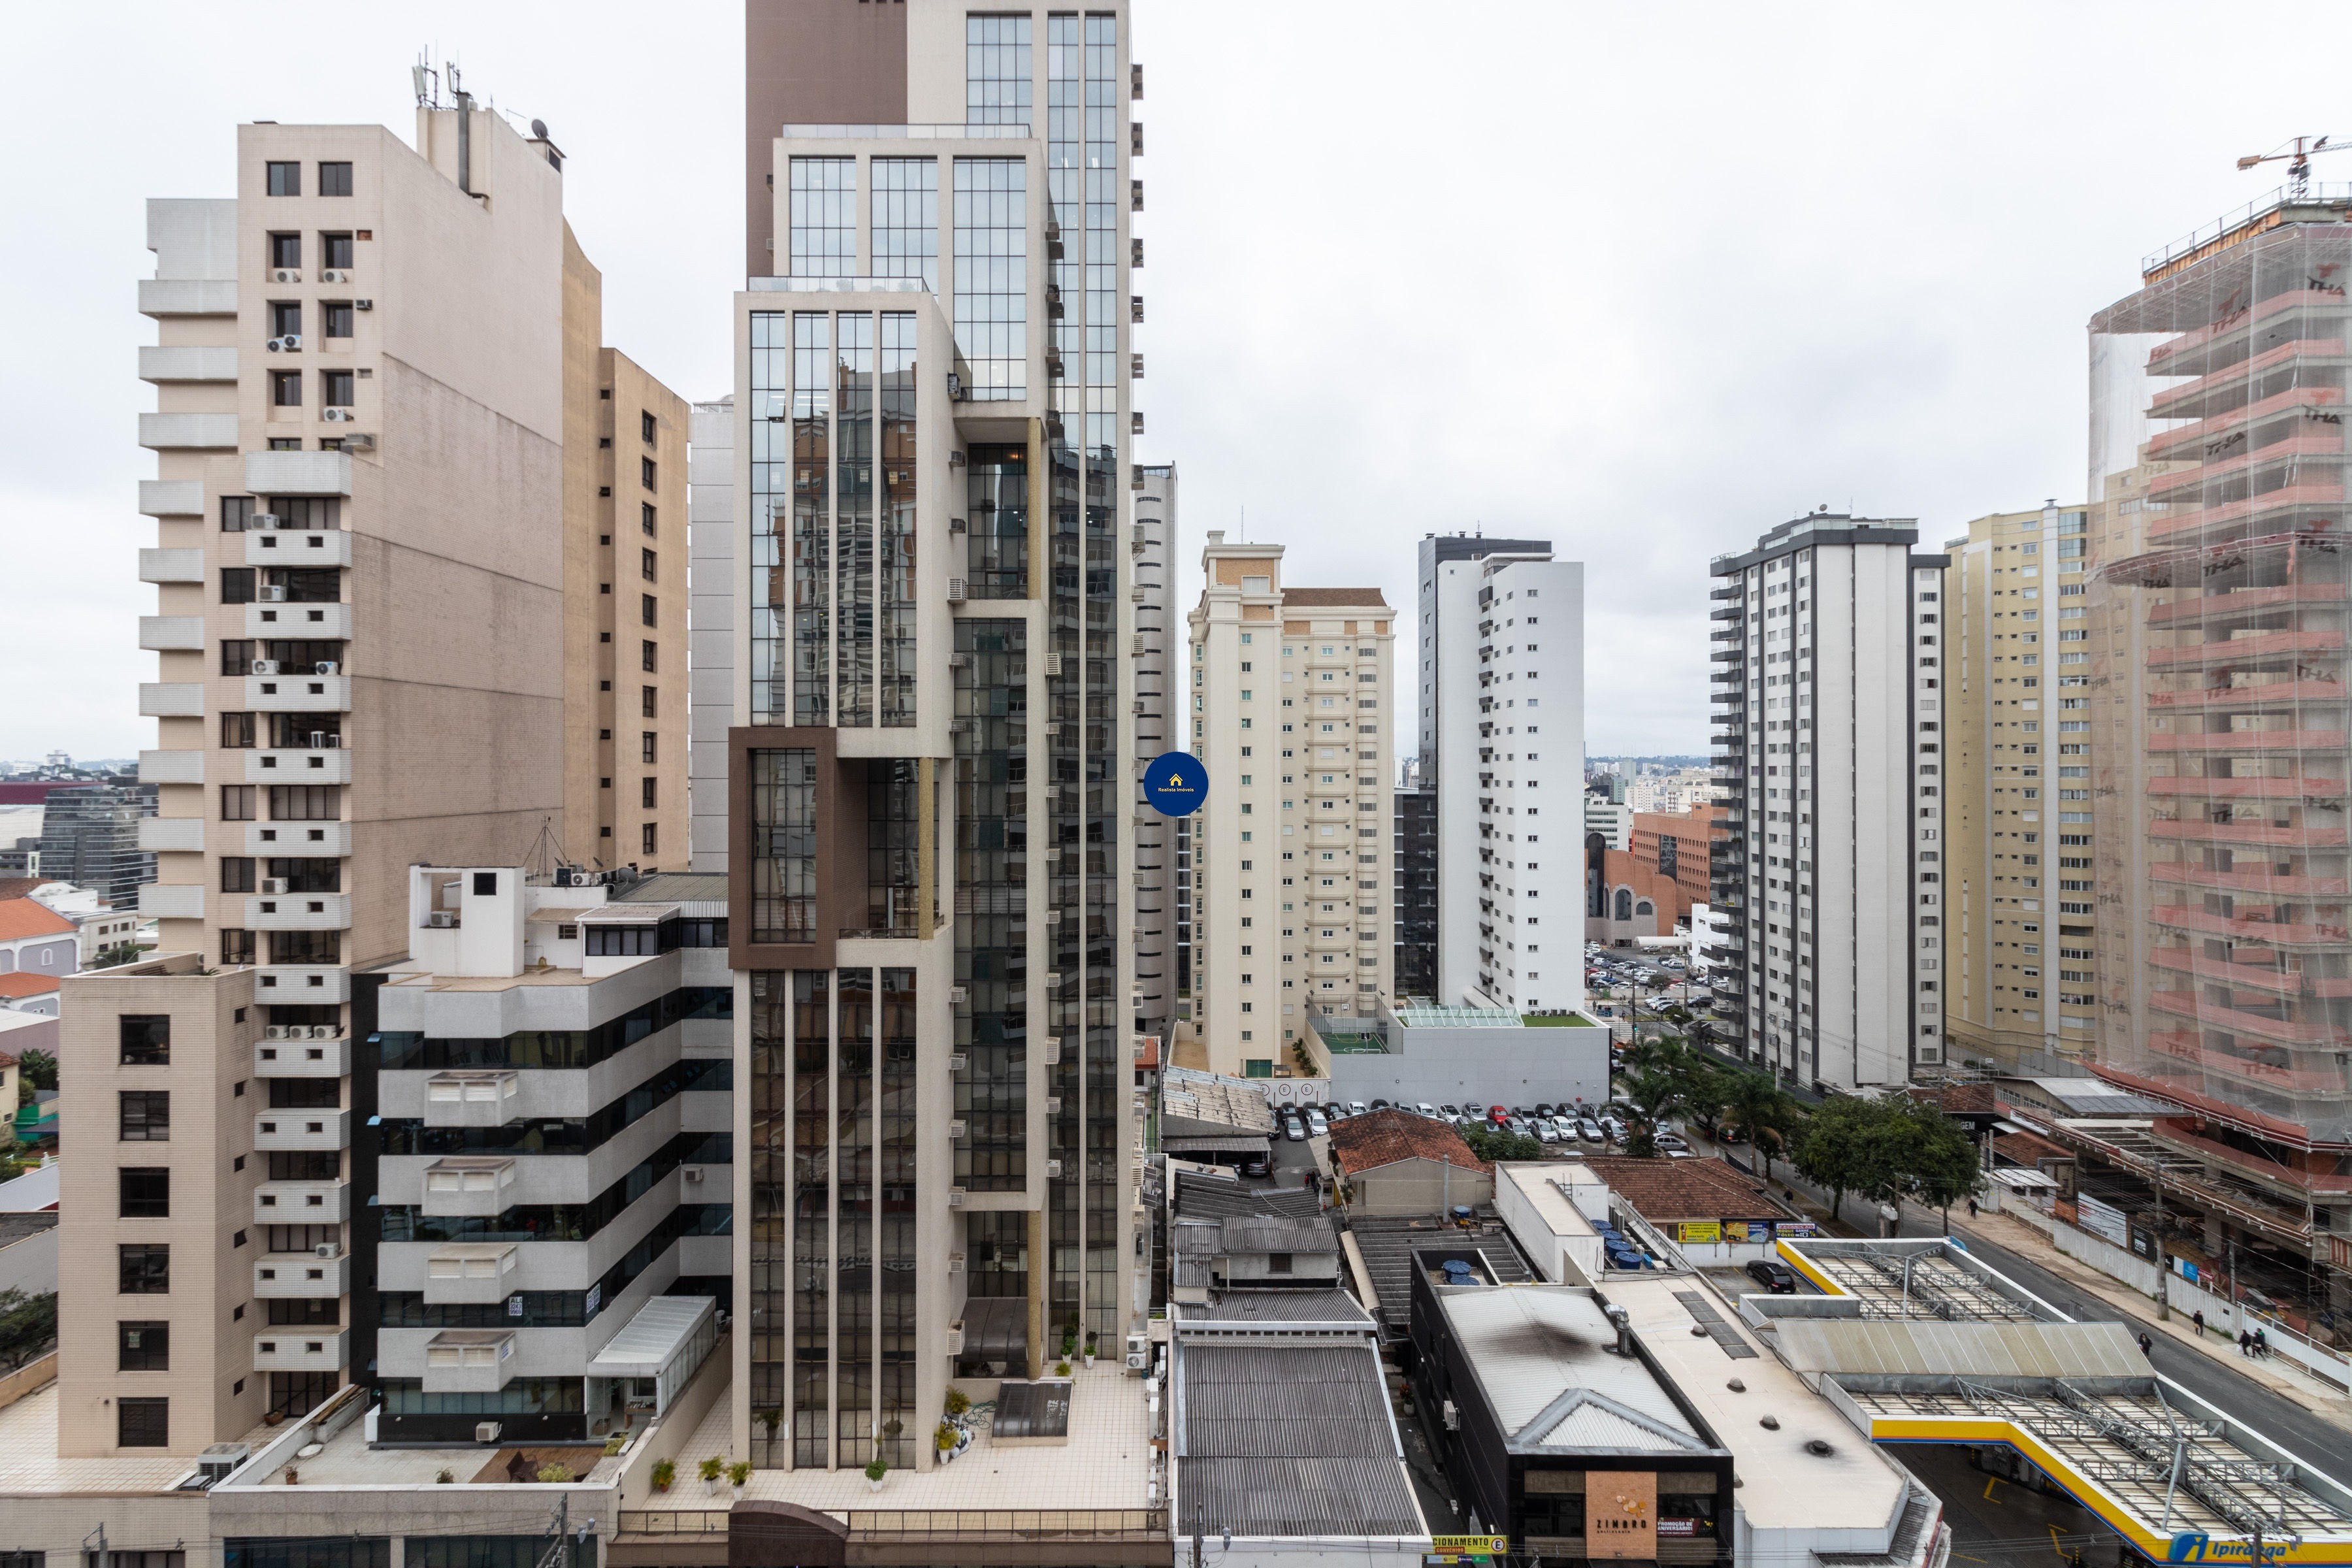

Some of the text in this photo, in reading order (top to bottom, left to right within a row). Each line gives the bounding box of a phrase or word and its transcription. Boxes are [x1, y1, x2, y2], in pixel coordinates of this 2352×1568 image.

[1960, 1121, 1975, 1130] GEM
[1597, 1520, 1646, 1528] ZIMBRO
[1433, 1537, 1488, 1546] CIONAMENTO
[1495, 1540, 1501, 1549] E
[2212, 1542, 2287, 1558] Ipiraga
